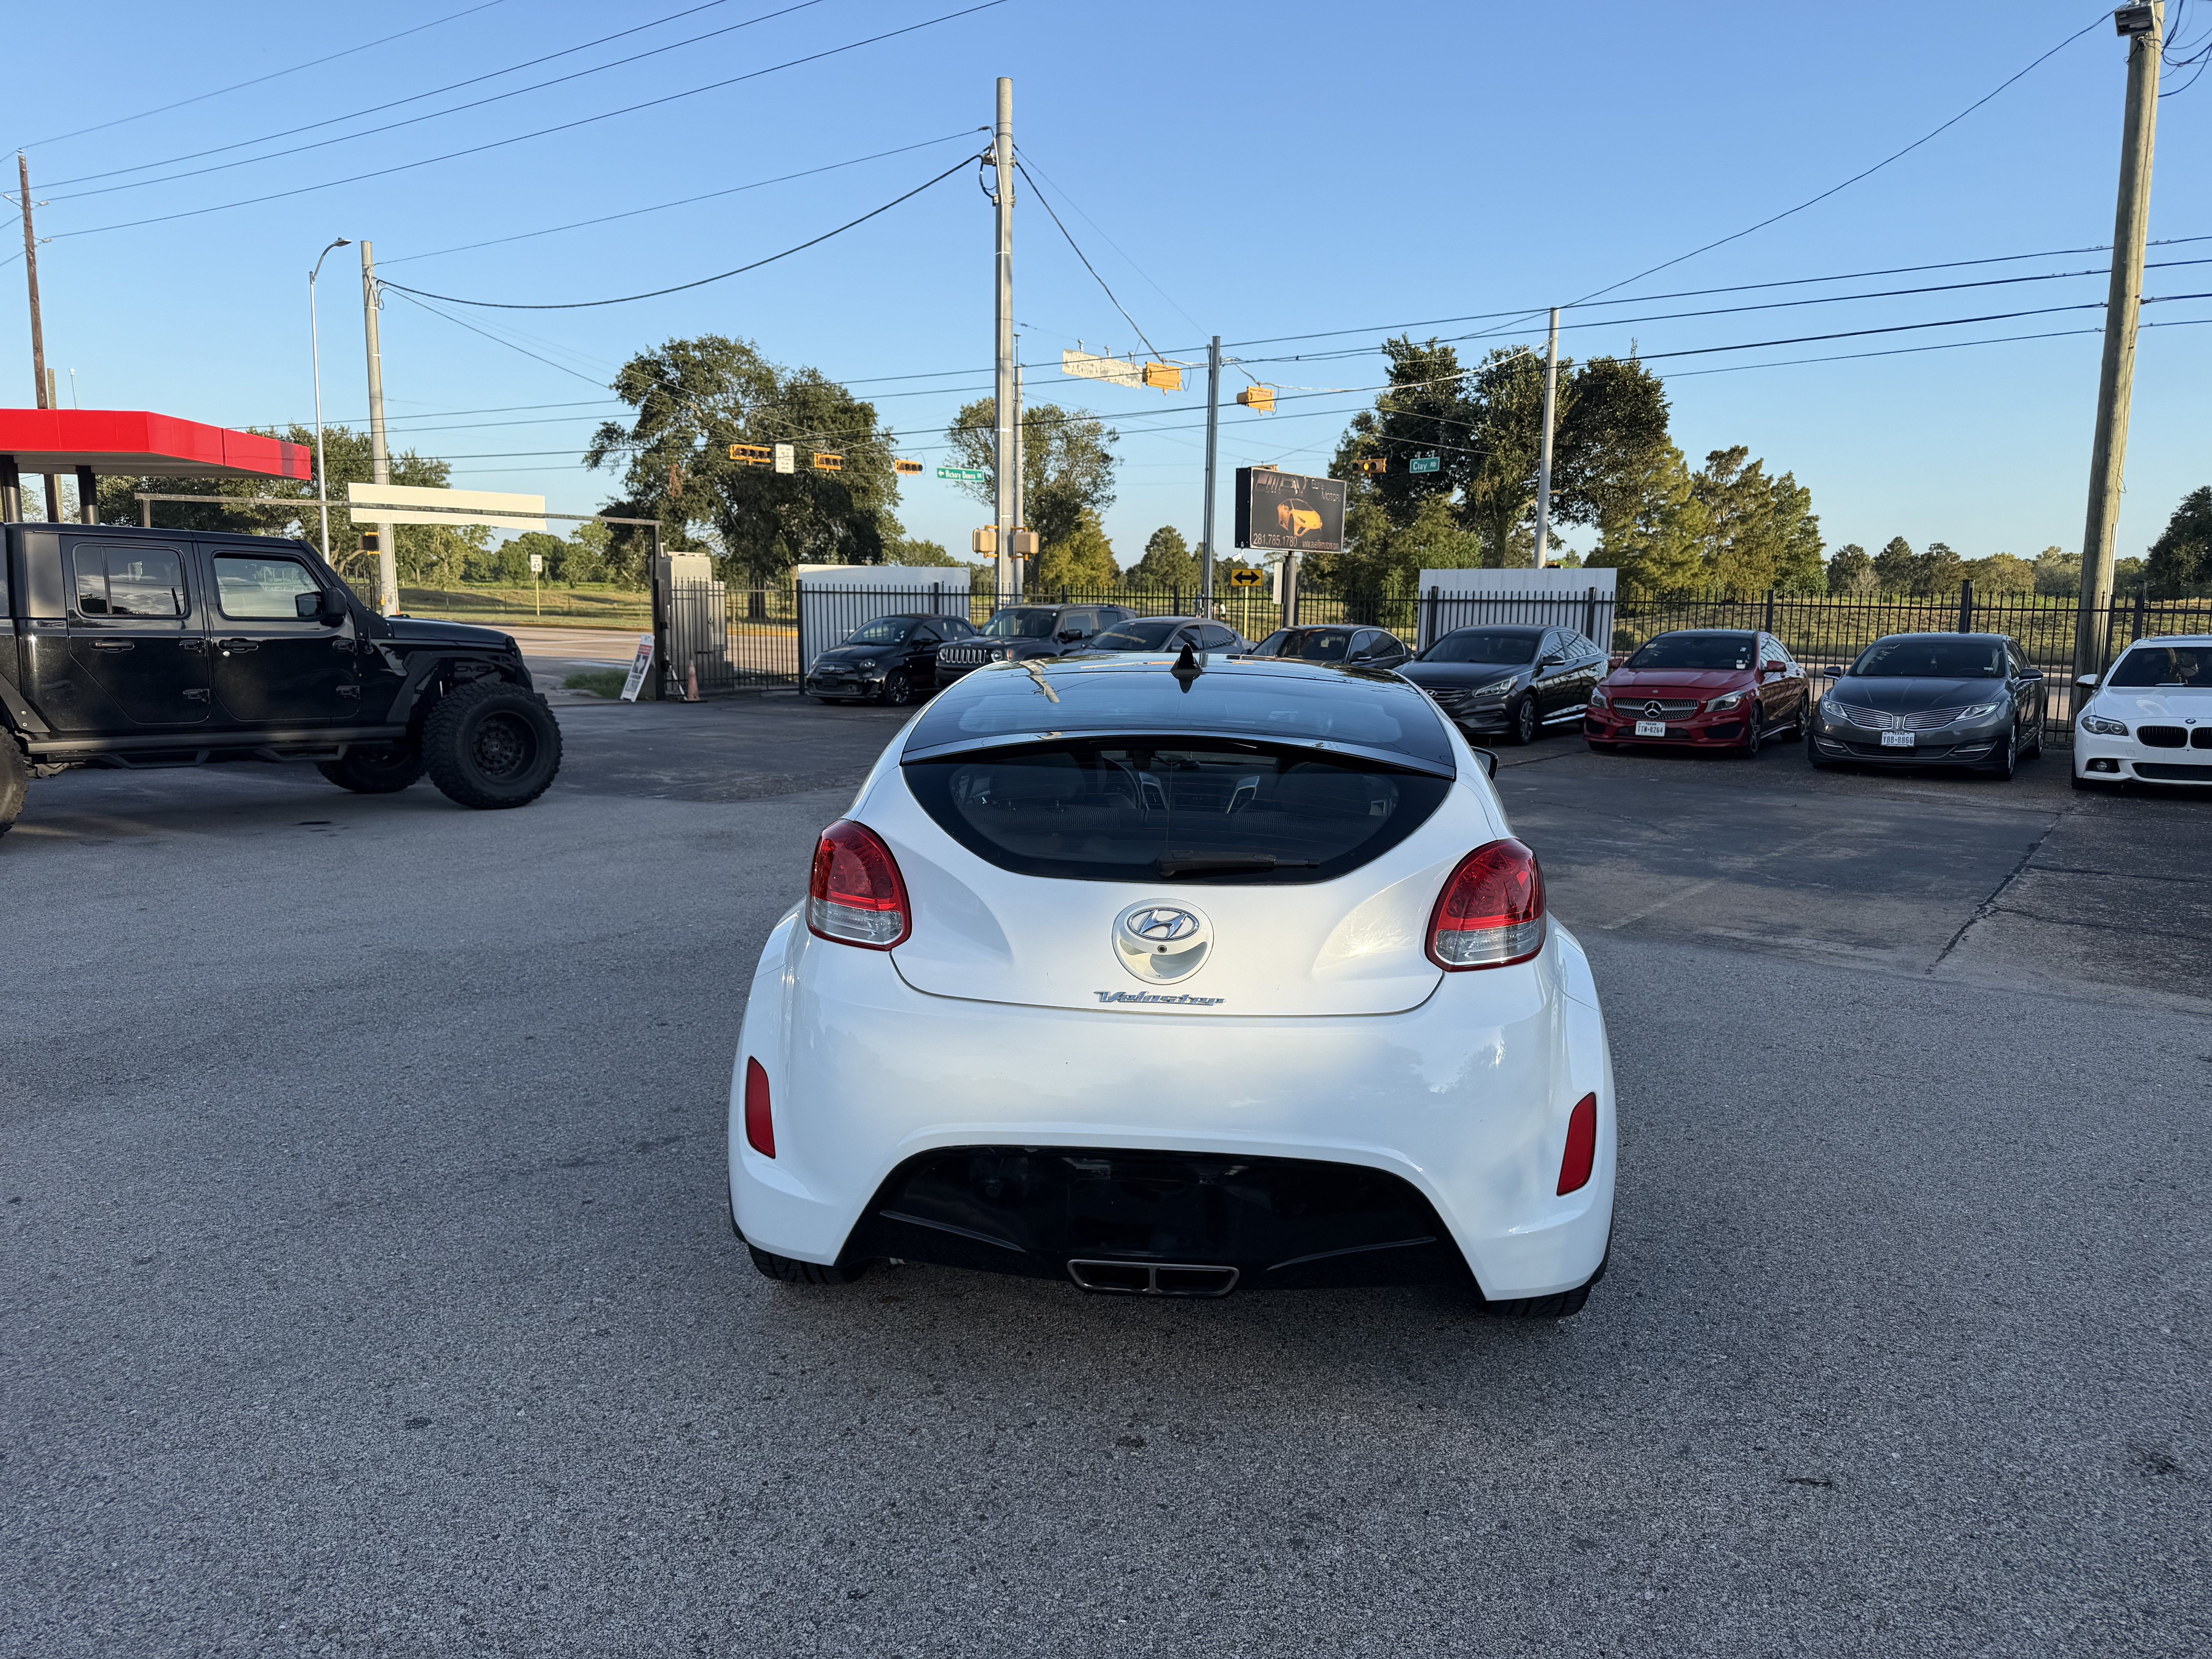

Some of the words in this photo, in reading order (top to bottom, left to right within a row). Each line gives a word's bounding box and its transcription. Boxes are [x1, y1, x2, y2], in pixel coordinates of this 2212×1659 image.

[1413, 462, 1427, 471] Clay
[1253, 533, 1297, 547] 281.785.1780
[1093, 991, 1226, 1006] Veloster
